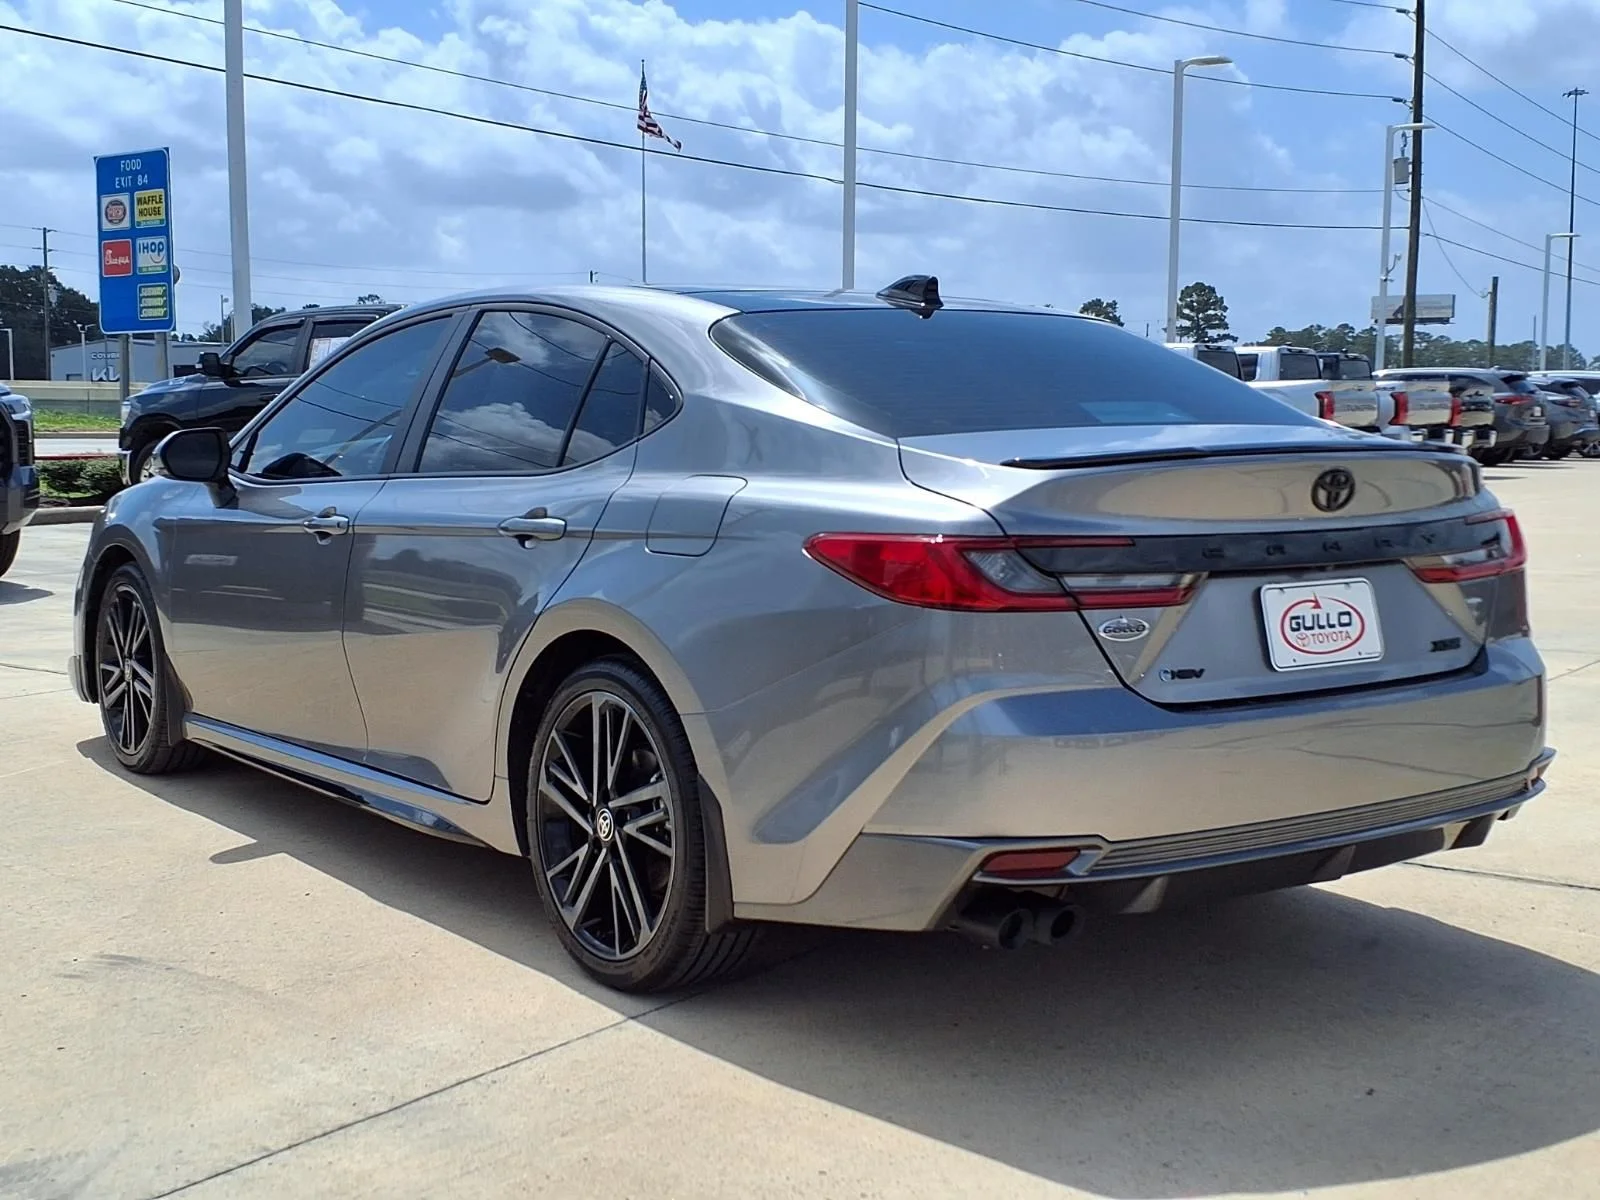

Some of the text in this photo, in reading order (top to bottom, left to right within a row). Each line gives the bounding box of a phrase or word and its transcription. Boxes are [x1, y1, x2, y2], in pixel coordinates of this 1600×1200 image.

[120, 158, 142, 171] FOOD
[115, 174, 148, 189] EXIT 84
[136, 194, 163, 206] WAFFLE
[138, 206, 162, 217] HOUSE
[138, 241, 165, 257] IHOP
[1289, 610, 1353, 632] GULLO
[1310, 630, 1353, 645] TOYOTA
